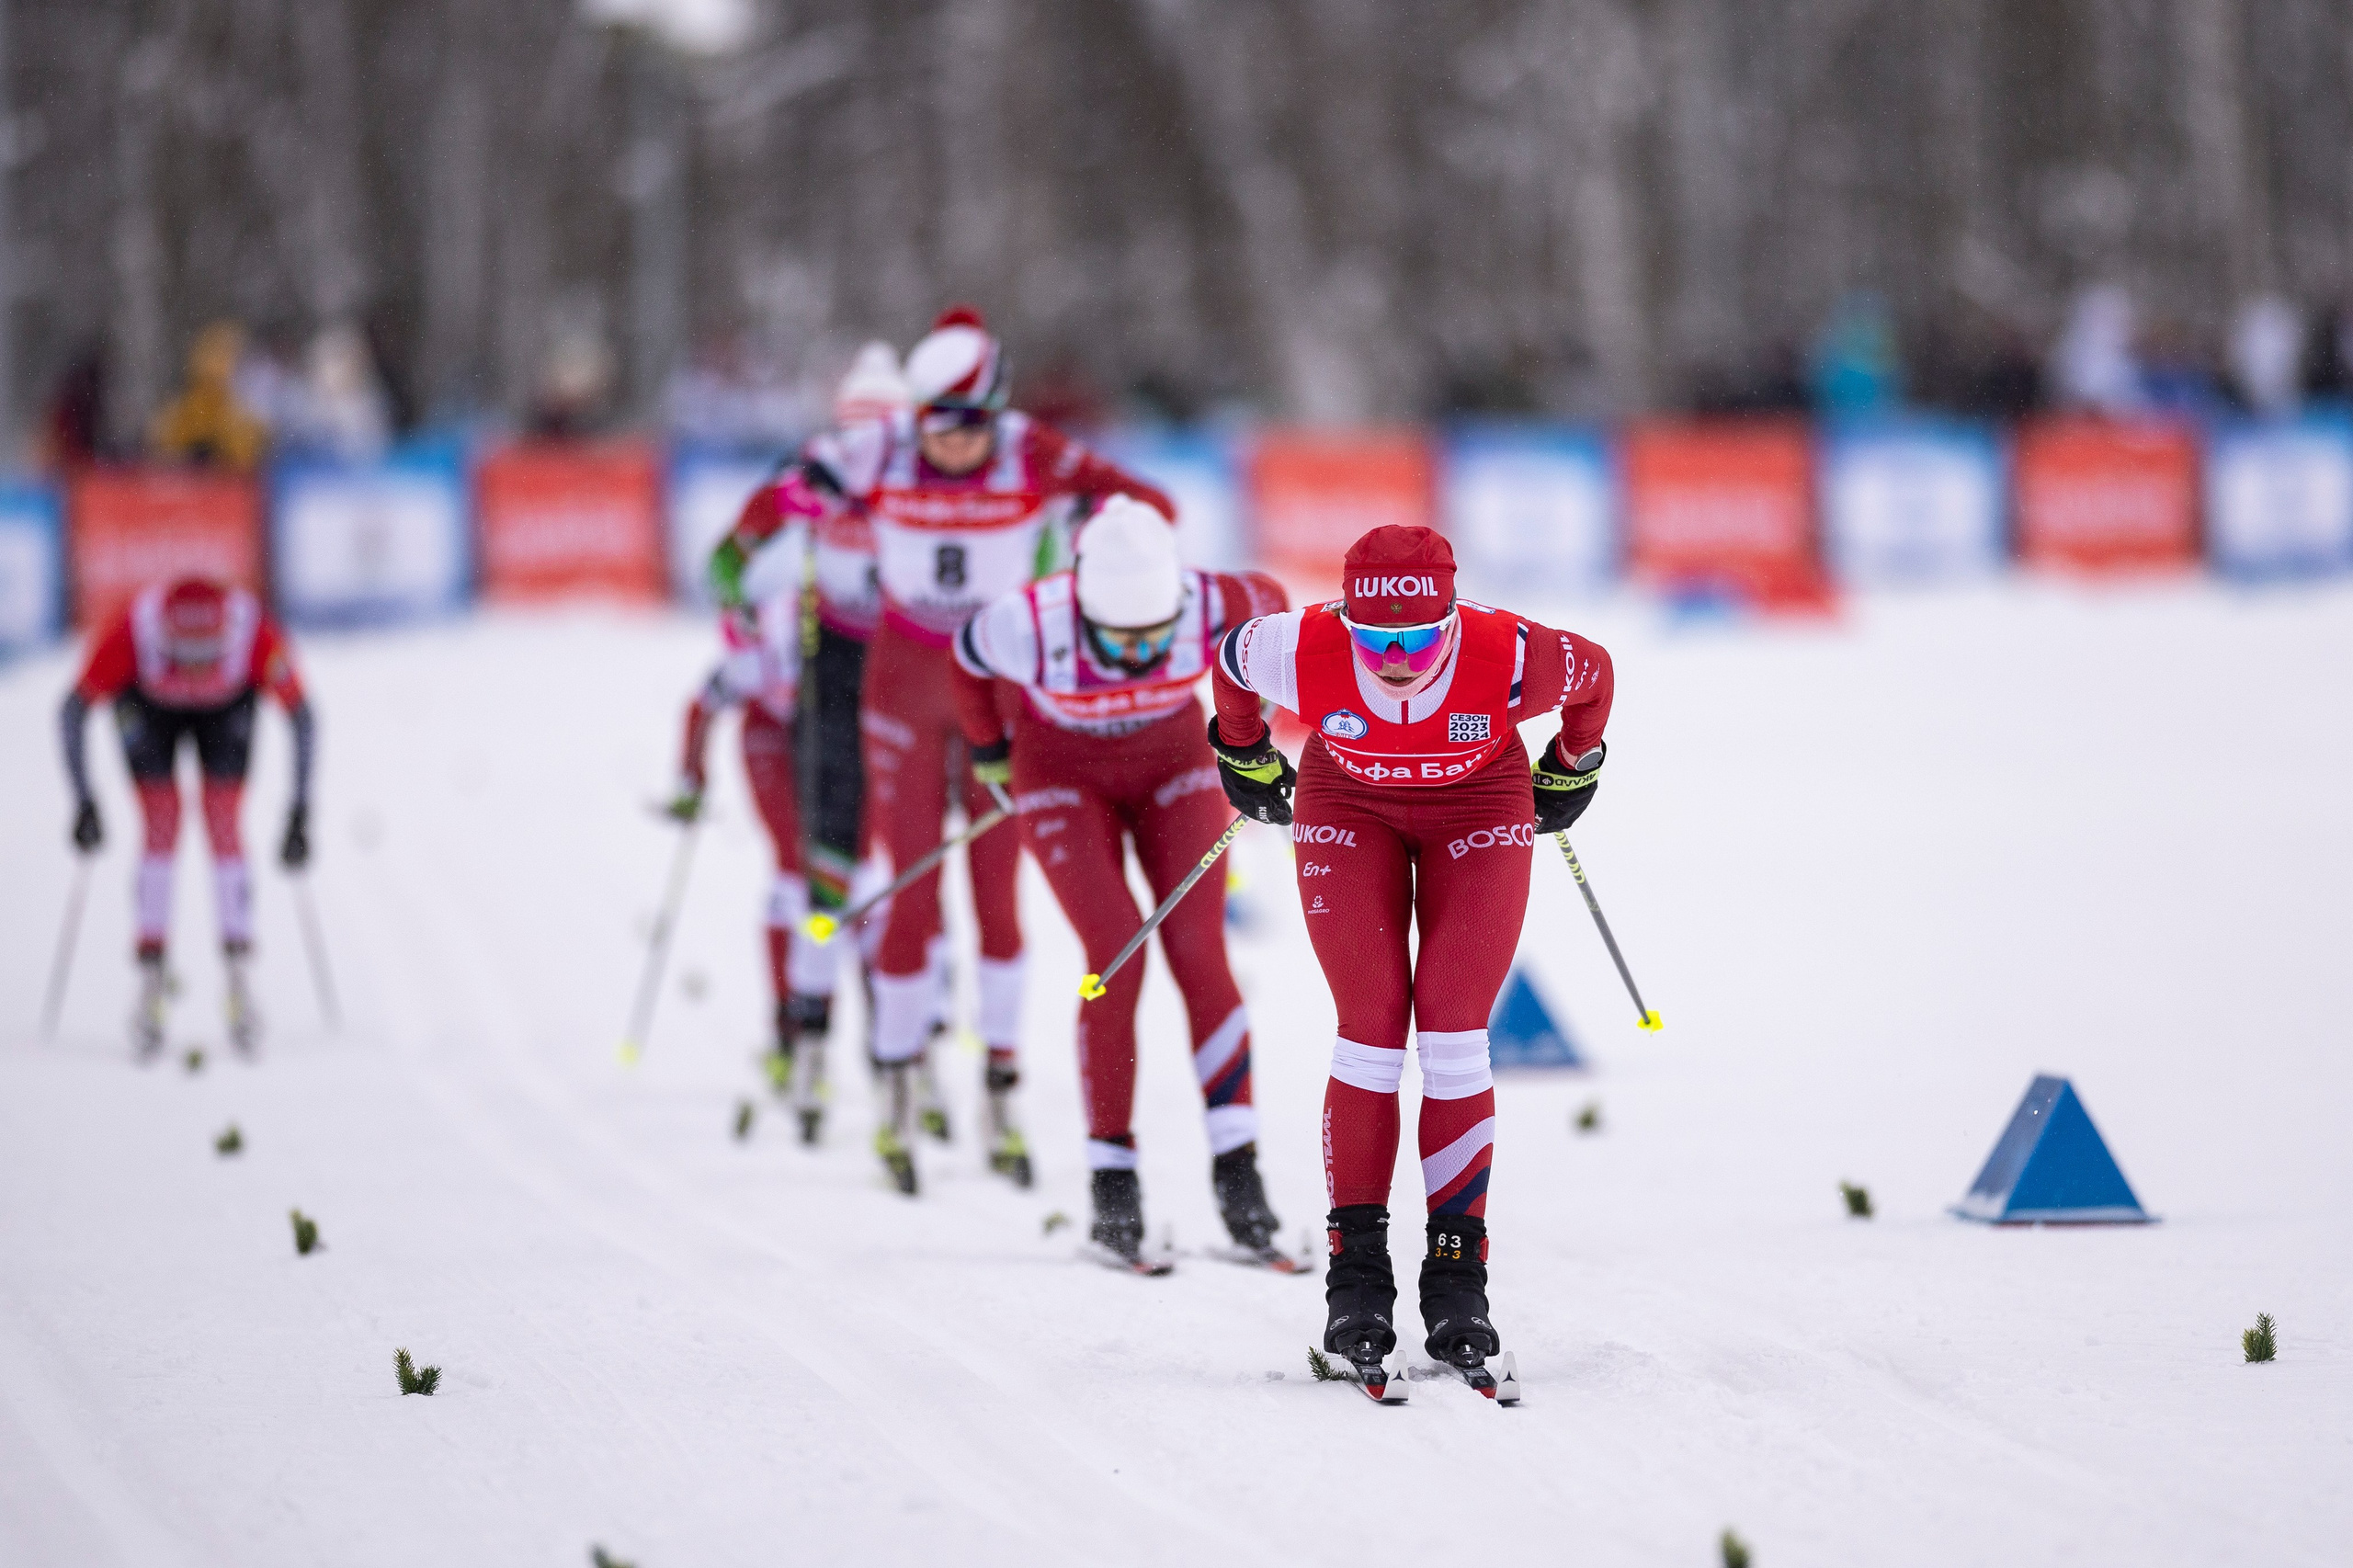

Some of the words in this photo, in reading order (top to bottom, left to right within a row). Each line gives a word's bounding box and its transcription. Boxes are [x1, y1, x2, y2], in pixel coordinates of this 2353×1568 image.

[1355, 575, 1438, 598] LUKOIL
[1242, 619, 1264, 696] BOSC
[1449, 713, 1489, 722] СЕЗОН
[1449, 722, 1489, 732] 2023
[1449, 732, 1490, 742] 2024
[1324, 740, 1413, 781] льфа
[1420, 748, 1488, 779] Бан
[1292, 821, 1358, 847] LUKOIL
[1447, 823, 1534, 860] BOSCO
